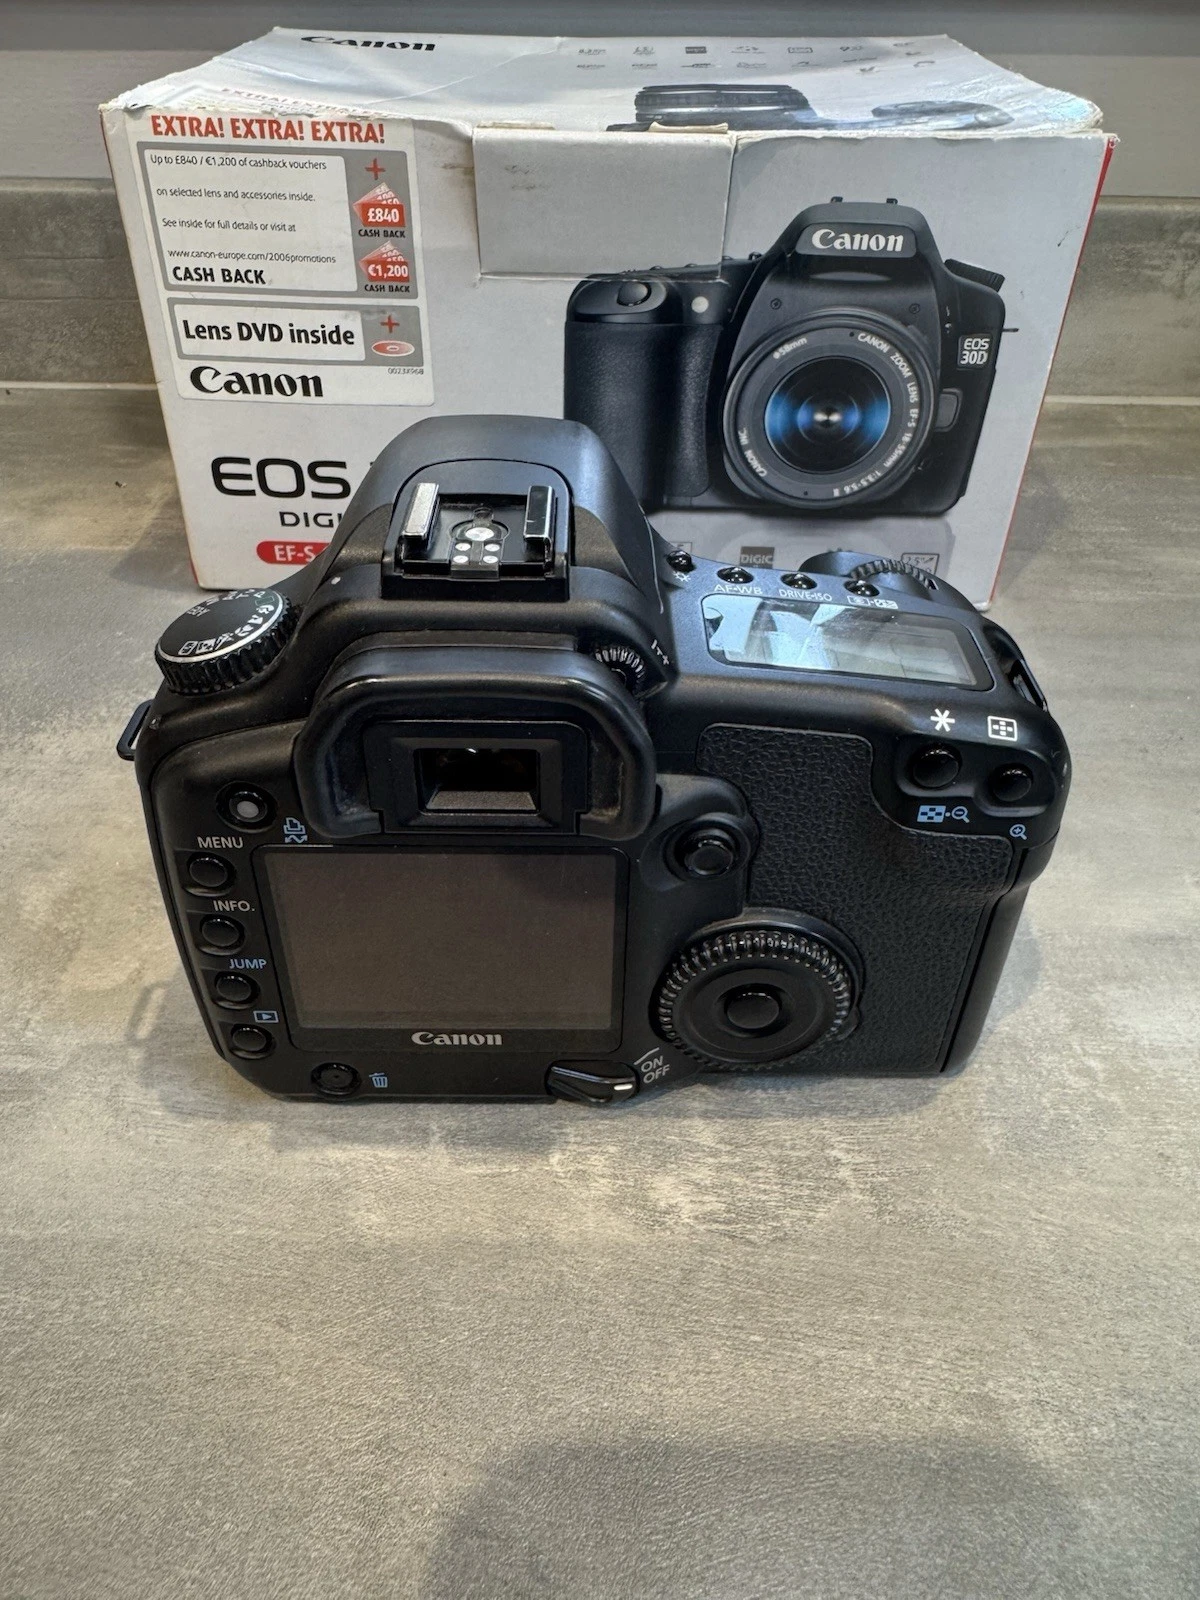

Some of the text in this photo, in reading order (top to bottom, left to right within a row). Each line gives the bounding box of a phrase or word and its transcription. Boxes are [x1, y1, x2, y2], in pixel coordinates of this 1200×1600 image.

[301, 36, 436, 51] Canon
[150, 115, 385, 144] EXTRA! EXTRA! EXTRA!
[150, 154, 162, 166] Up
[165, 155, 173, 164] to
[175, 156, 198, 165] £840
[205, 157, 236, 167] €1,200
[238, 157, 248, 166] of
[249, 158, 288, 168] cashback
[289, 159, 327, 170] vouchers
[157, 187, 315, 202] on selected lens and accessories inside.
[367, 207, 400, 223] £840
[162, 218, 296, 232] See inside for full details or visit at
[358, 229, 406, 238] CASH BACK
[811, 228, 904, 253] Canon
[168, 249, 336, 264] www.canon-europe.com/2006promotions
[172, 266, 266, 285] CASH BACK
[367, 264, 408, 279] €1,200
[364, 284, 410, 293] CASH BACK
[183, 320, 355, 345] Lens DVD inside
[857, 333, 891, 353] CANON
[963, 338, 990, 350] EOS
[890, 352, 913, 379] ZOOM
[960, 350, 989, 365] 30D
[190, 366, 324, 398] Canon
[907, 381, 919, 403] LENS
[907, 408, 919, 428] EF-S
[211, 456, 352, 499] EOS
[273, 544, 316, 562] EF-S
[740, 554, 773, 565] DIGIC
[197, 836, 244, 849] MENU
[213, 900, 255, 912] INFO.
[229, 958, 267, 970] JUMP
[411, 1031, 503, 1046] Canon
[640, 1055, 664, 1073] ON
[643, 1065, 671, 1084] OFF
